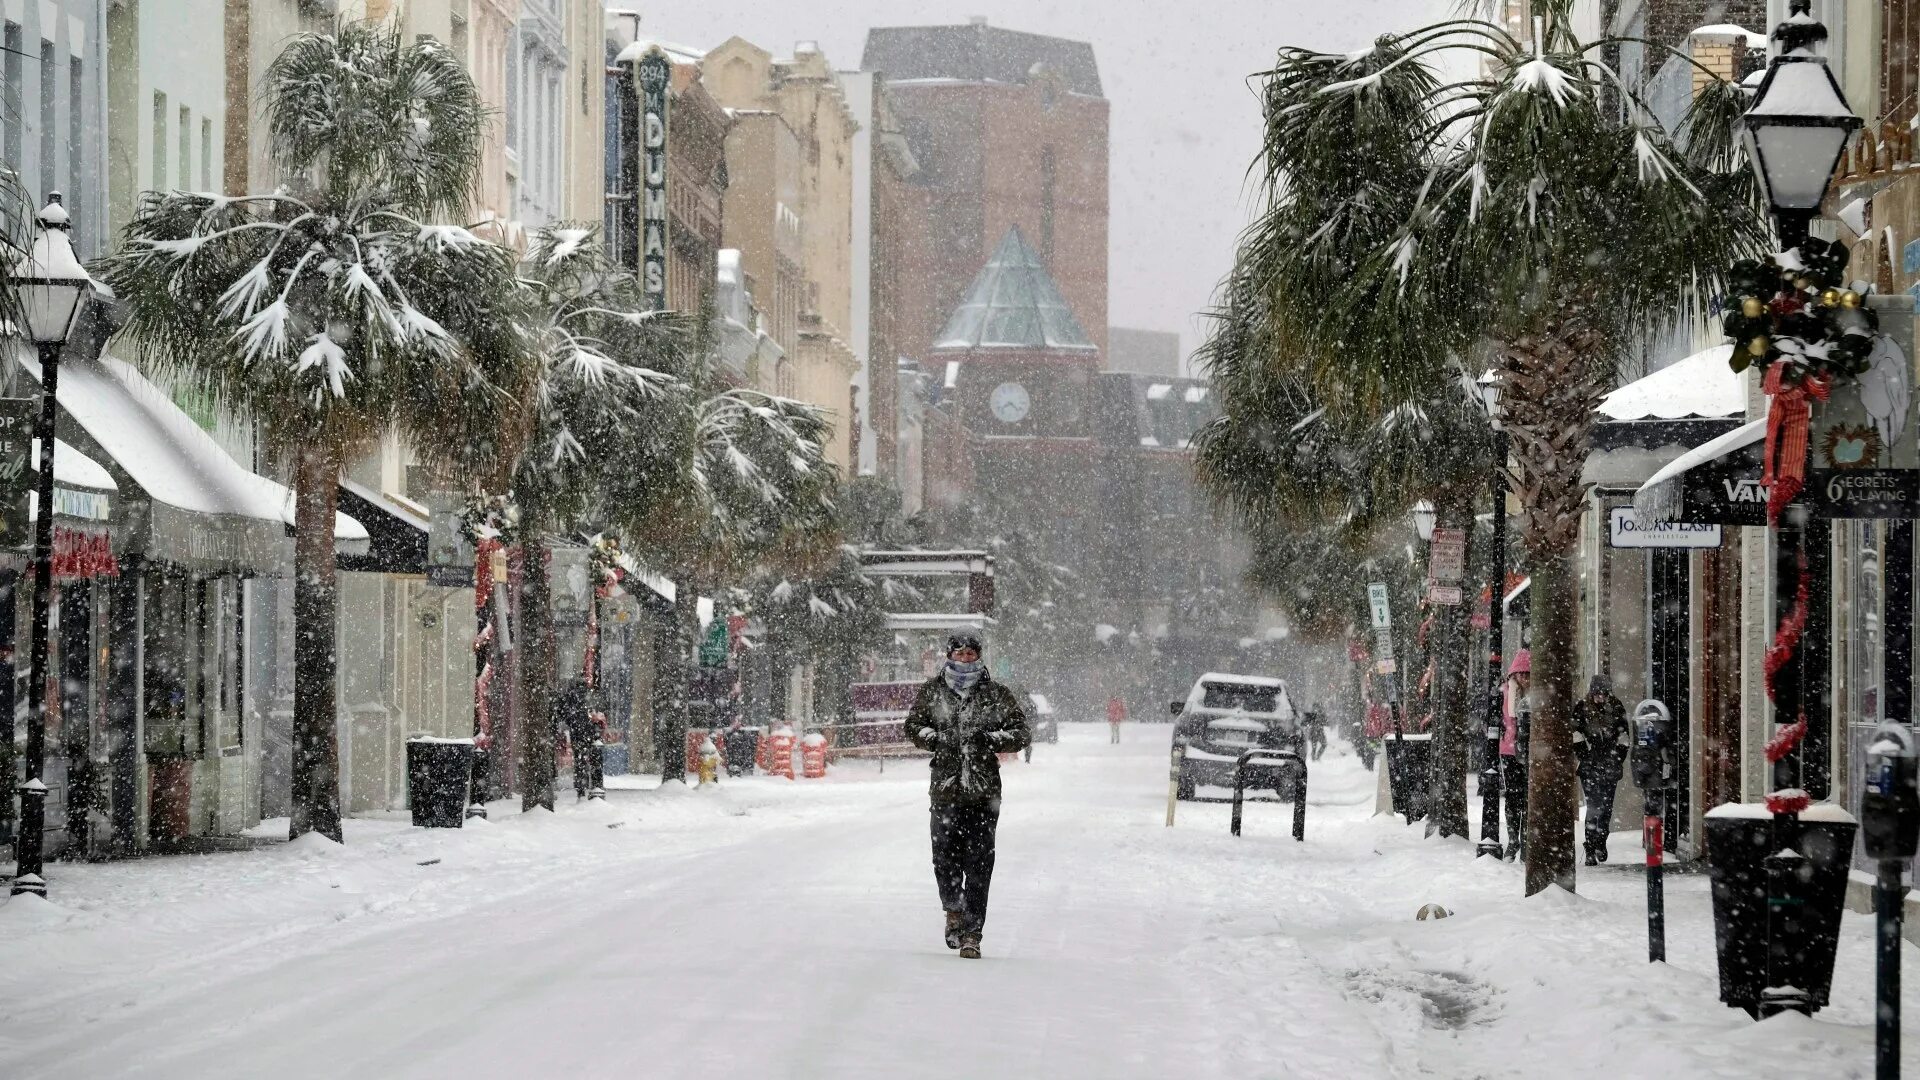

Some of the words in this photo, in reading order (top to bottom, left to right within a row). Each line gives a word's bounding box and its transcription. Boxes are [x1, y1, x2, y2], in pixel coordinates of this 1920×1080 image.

[640, 64, 666, 81] 294
[644, 112, 664, 294] DUMAS
[1827, 474, 1843, 501] 6
[1845, 476, 1895, 488] EGRETS
[1846, 490, 1906, 501] A-LAYING
